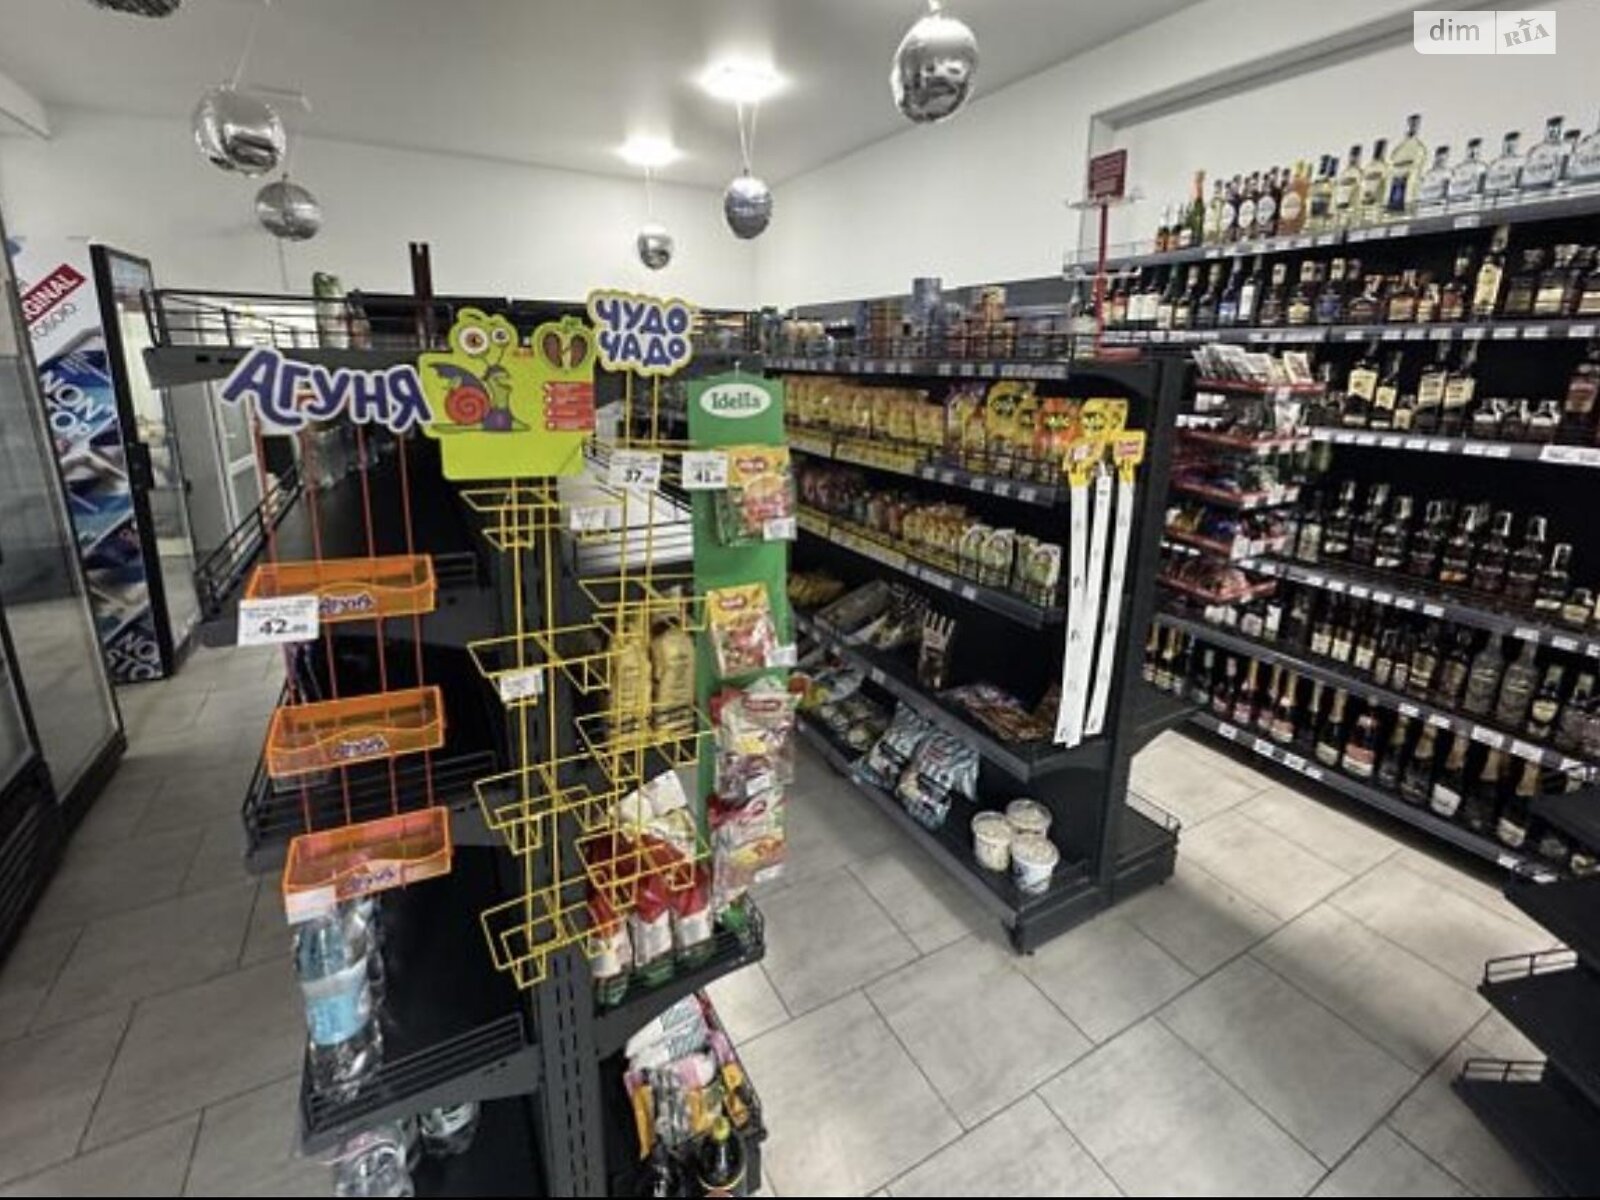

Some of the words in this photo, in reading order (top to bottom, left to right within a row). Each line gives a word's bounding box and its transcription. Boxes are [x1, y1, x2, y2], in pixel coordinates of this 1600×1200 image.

[23, 273, 75, 320] GINAL
[596, 299, 689, 335] ЧУДО
[599, 331, 687, 366] ЧАДО
